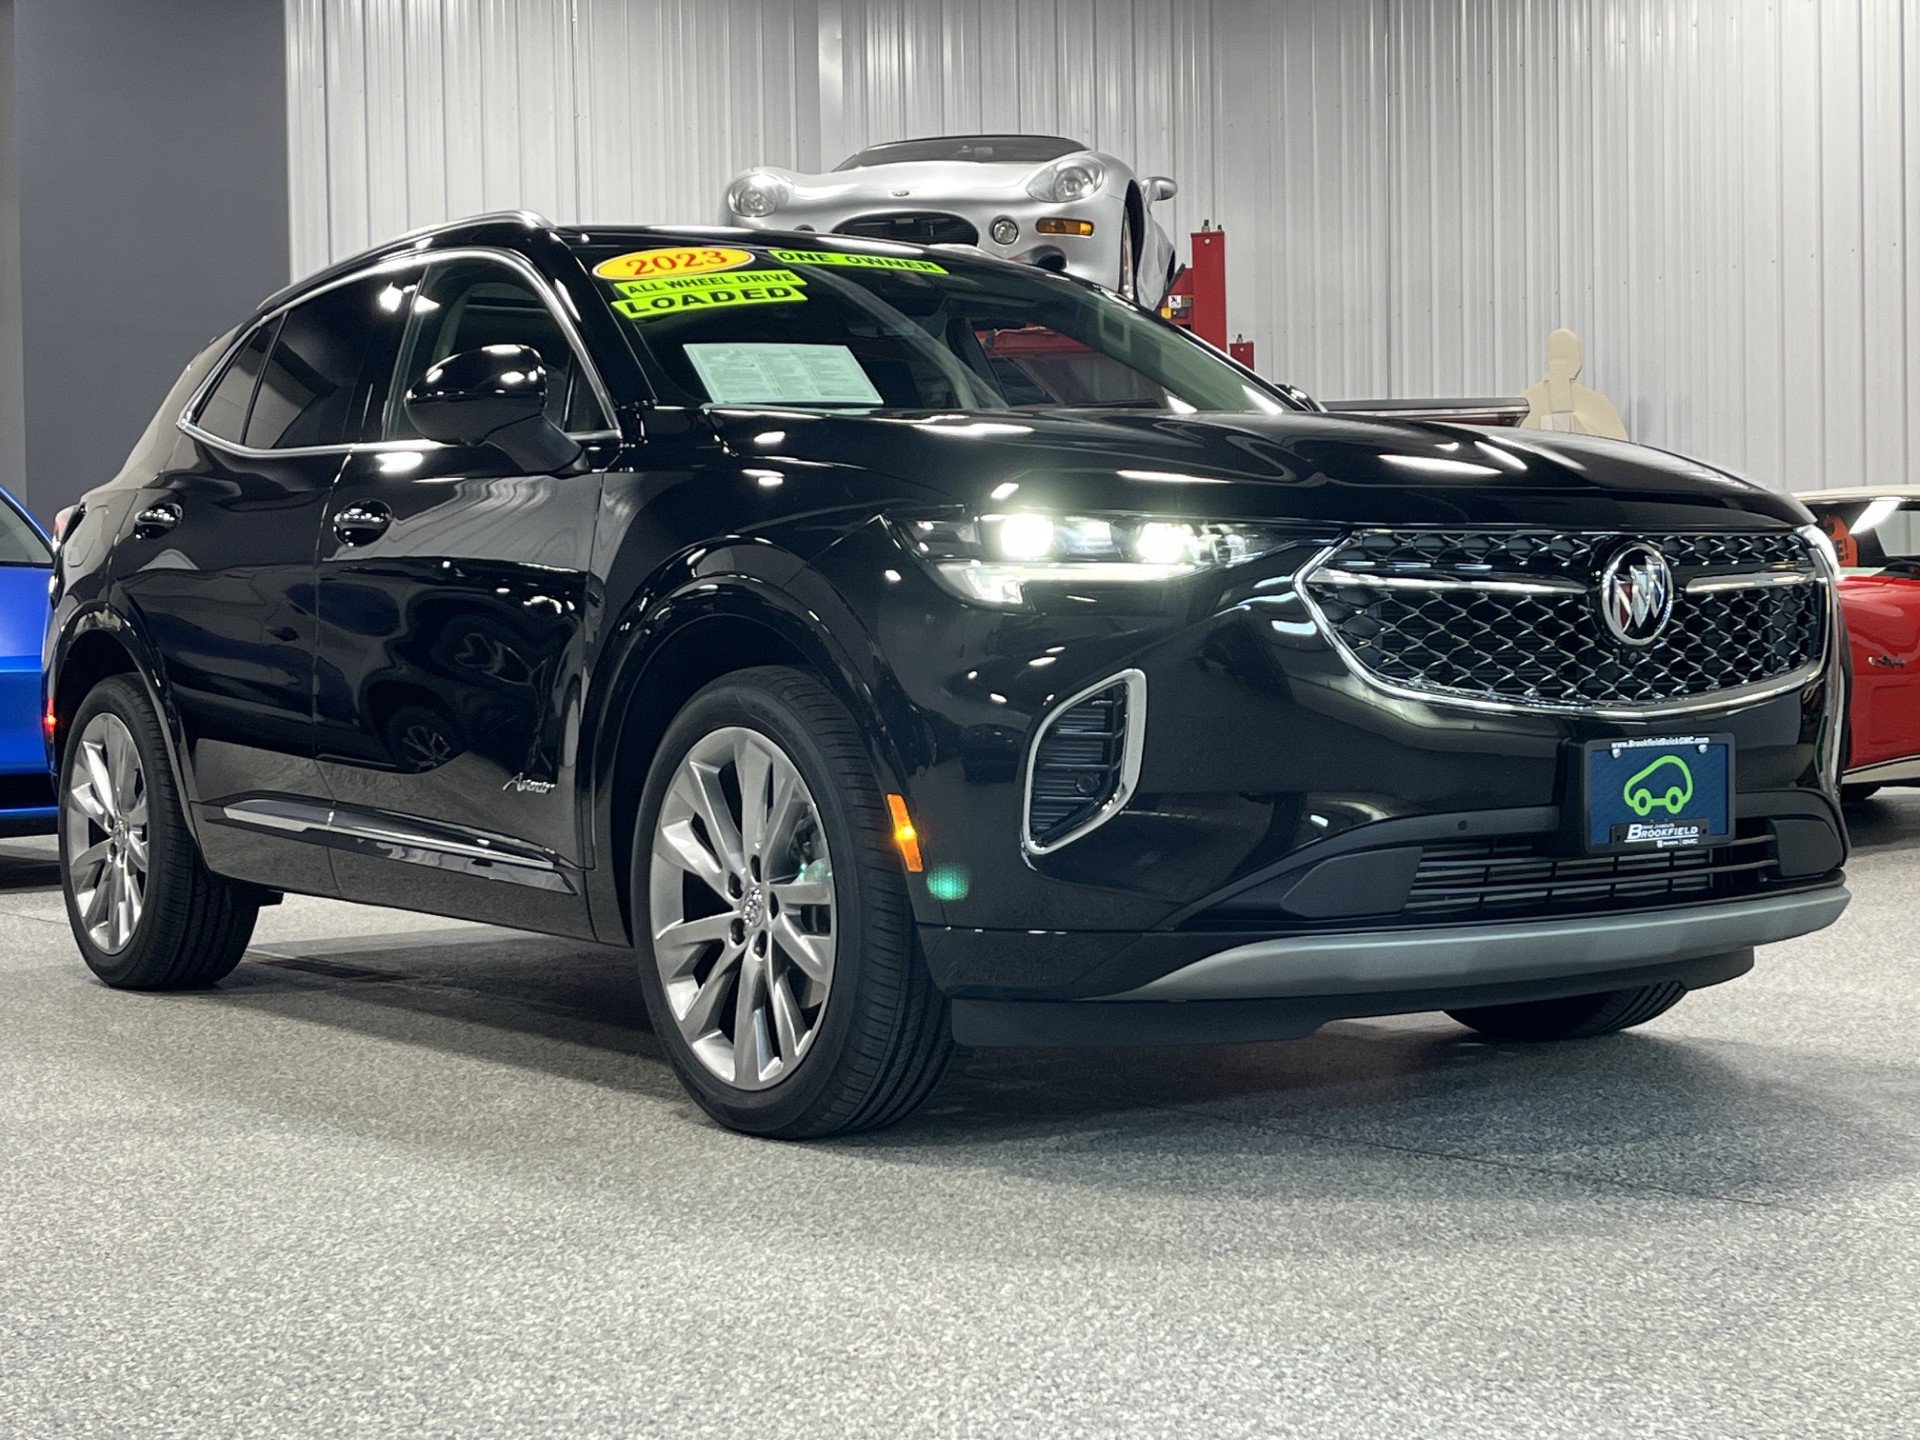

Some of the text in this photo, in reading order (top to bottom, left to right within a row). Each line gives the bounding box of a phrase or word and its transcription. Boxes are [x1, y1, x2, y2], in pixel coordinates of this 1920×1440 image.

[626, 250, 728, 276] 2023
[778, 252, 941, 272] ONE OWNER
[627, 272, 796, 295] ALL WHEEL DRIVE
[625, 286, 793, 314] LOADED
